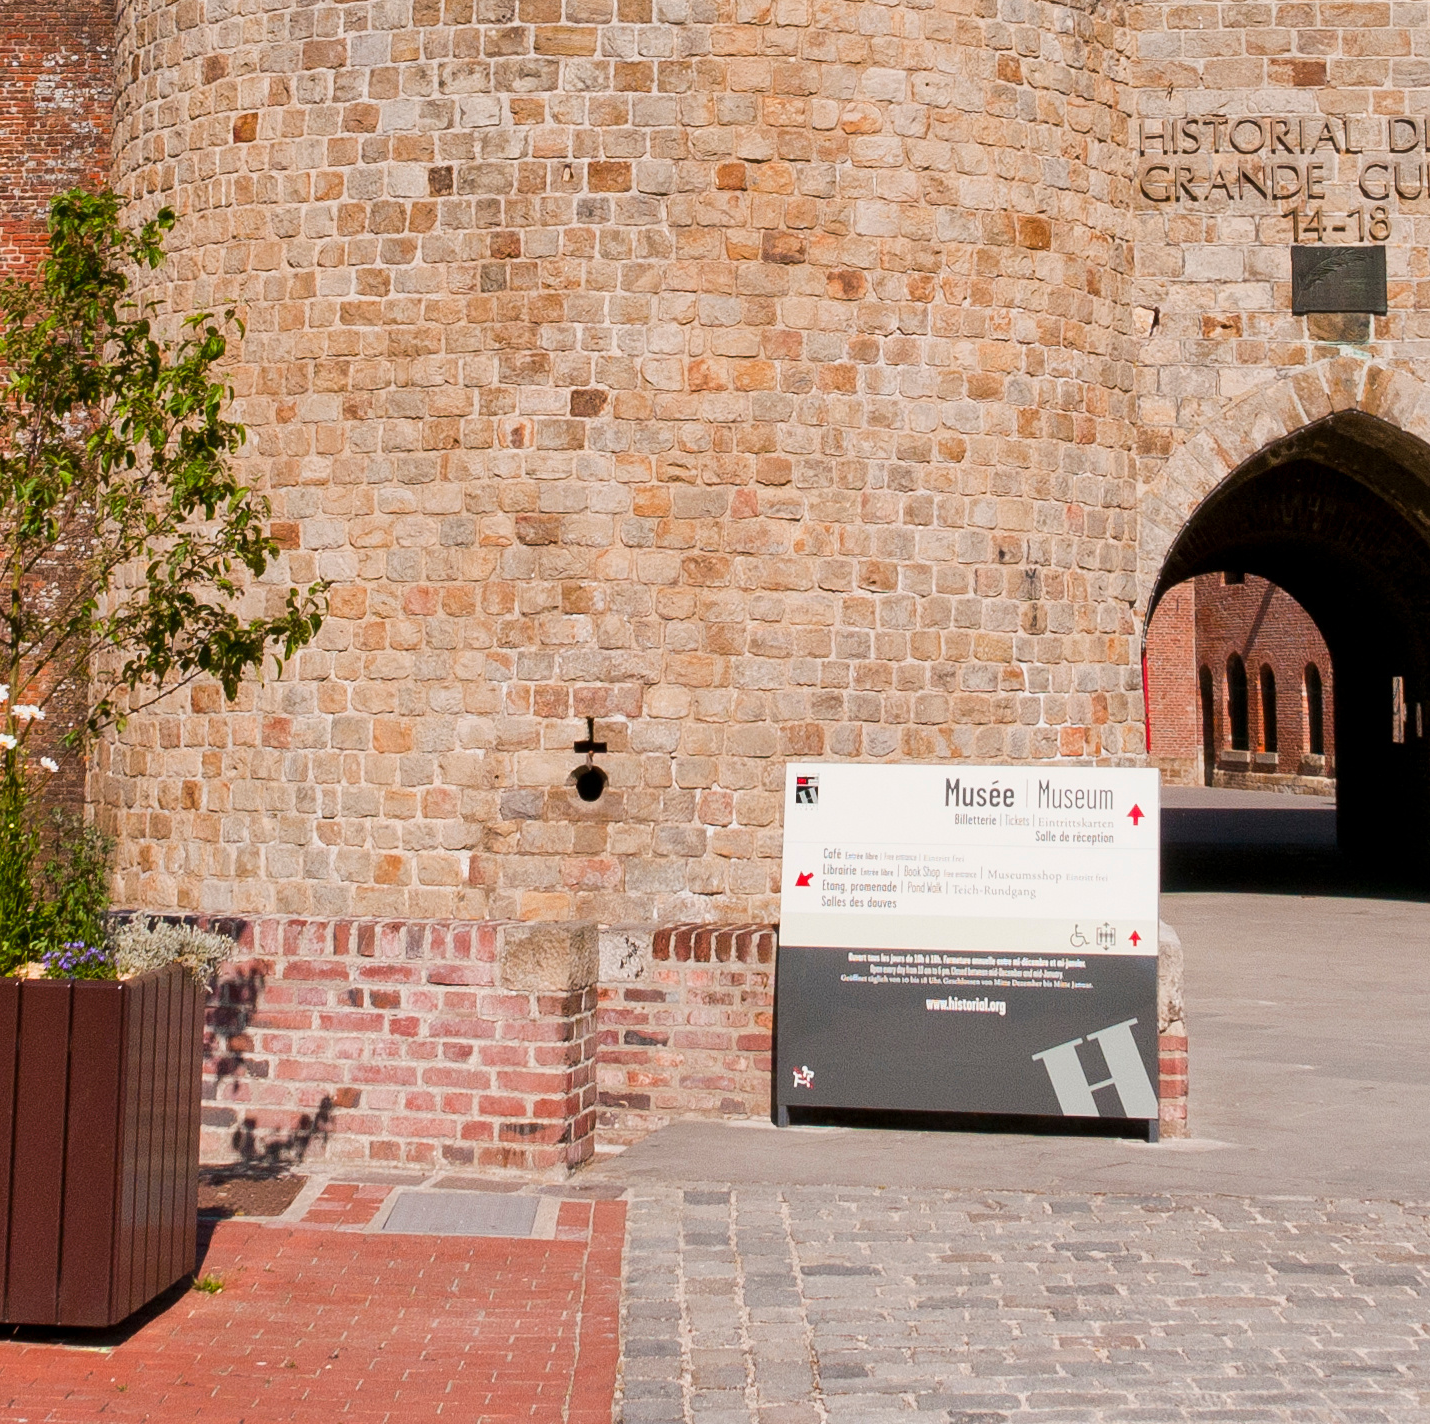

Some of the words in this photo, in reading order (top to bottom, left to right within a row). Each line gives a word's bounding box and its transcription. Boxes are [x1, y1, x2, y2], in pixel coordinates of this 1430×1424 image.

[1139, 117, 1363, 157] HISTORIAL
[1139, 161, 1326, 202] GRANDE
[1281, 204, 1392, 243] 14-18
[945, 777, 1015, 808] Musée
[1038, 779, 1114, 810] Museum
[954, 813, 997, 826] Billetterie
[1005, 814, 1030, 826] Tickets
[1038, 817, 1114, 829] Eintrittskarten
[1035, 830, 1056, 842] Salle
[1059, 831, 1070, 842] de
[1072, 832, 1114, 845] réception
[823, 848, 842, 859] Café
[822, 863, 857, 876] Librairie
[904, 865, 921, 877] Book
[923, 866, 940, 880] Shop
[988, 870, 1062, 884] Museumsshop
[851, 881, 897, 894] promenade
[908, 882, 925, 893] Pond
[927, 883, 942, 894] Walk
[952, 884, 1036, 899] Teich-Rundgang
[821, 895, 846, 907] Salles
[849, 896, 864, 908] des
[867, 897, 897, 908] douves
[926, 996, 1006, 1016] www.historial.org
